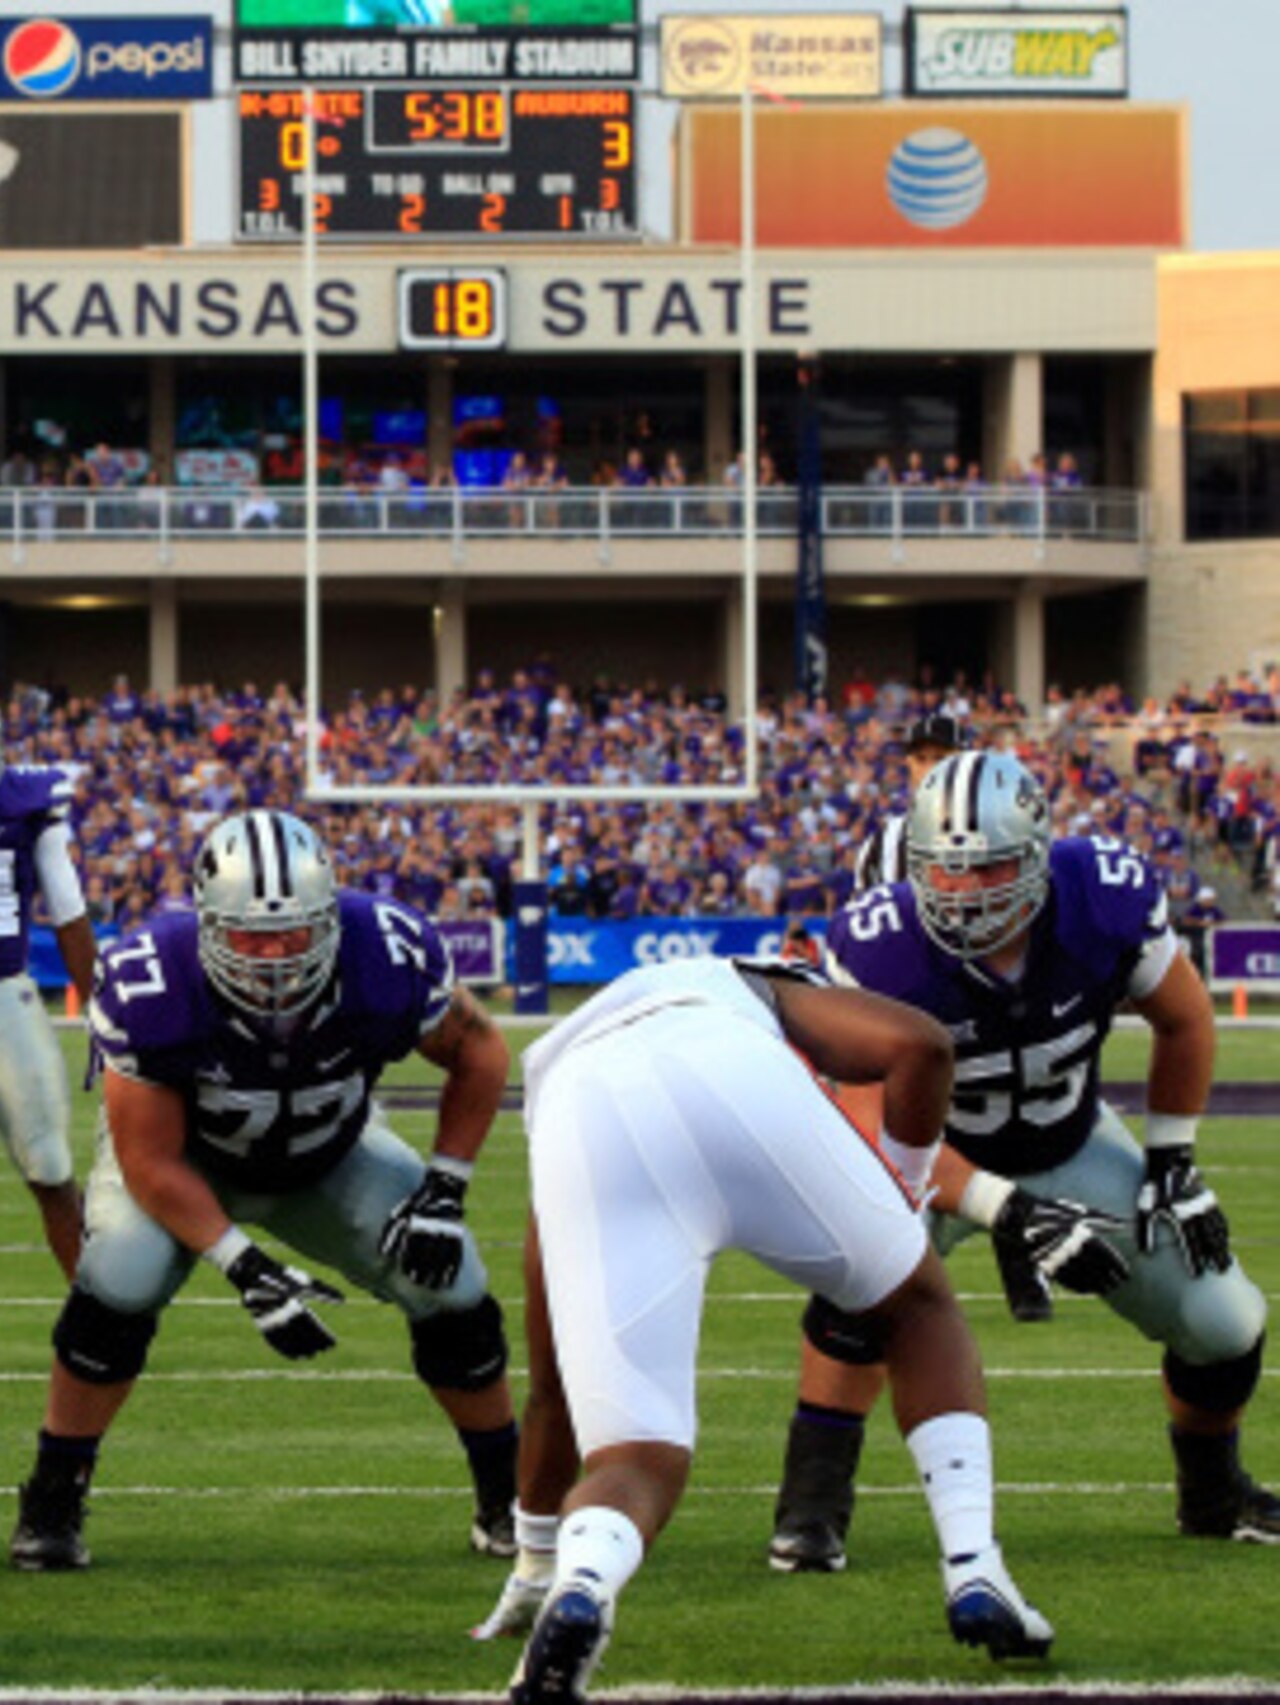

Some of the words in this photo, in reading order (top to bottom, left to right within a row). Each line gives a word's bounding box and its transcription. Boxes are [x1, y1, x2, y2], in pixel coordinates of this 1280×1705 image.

[86, 36, 205, 77] pepsi
[240, 41, 297, 76] BILL
[303, 41, 407, 76] SNYDER
[415, 41, 509, 76] FAMILY
[516, 40, 634, 76] STADIUM
[928, 28, 1116, 79] SUBWAY
[404, 93, 504, 140] 5:38
[280, 121, 308, 169] 0
[603, 120, 630, 168] 3
[399, 193, 425, 232] 2
[480, 193, 506, 232] 2
[559, 194, 572, 229] 1
[13, 281, 360, 338] KANSAS
[433, 280, 492, 338] 18
[541, 281, 812, 338] STATE
[633, 933, 718, 968] COX
